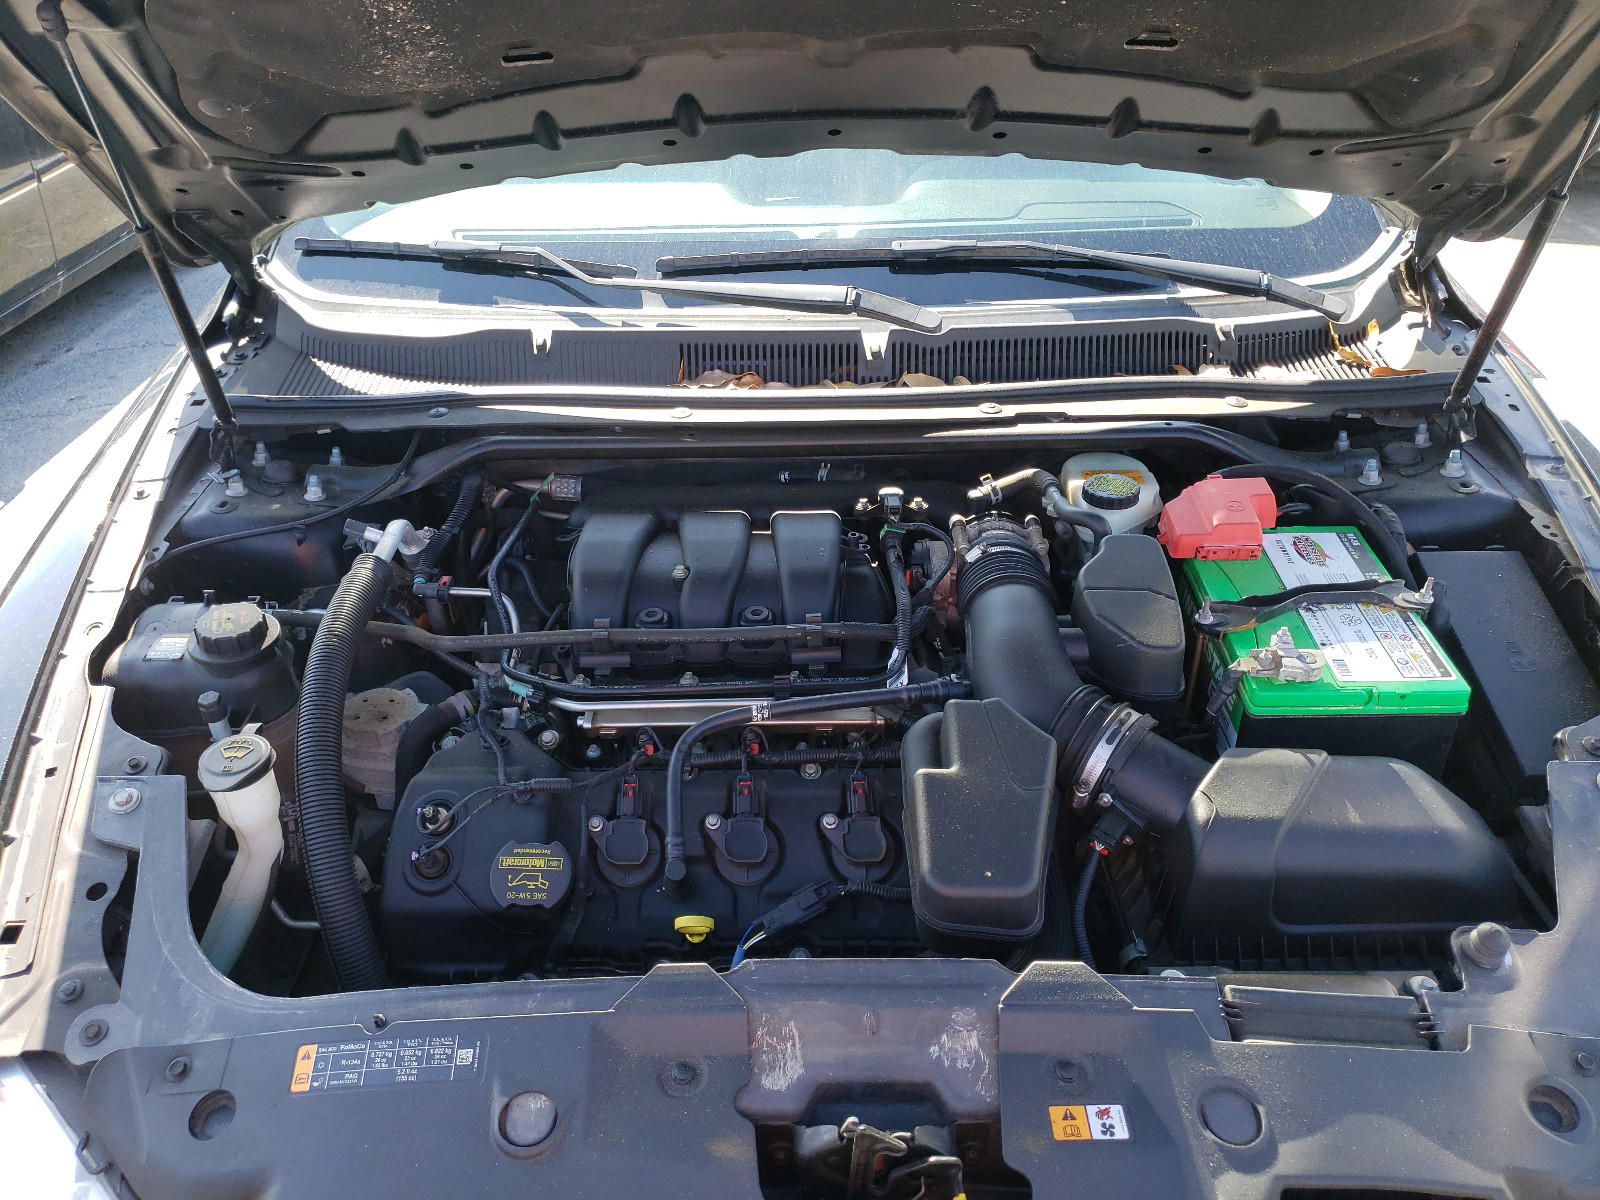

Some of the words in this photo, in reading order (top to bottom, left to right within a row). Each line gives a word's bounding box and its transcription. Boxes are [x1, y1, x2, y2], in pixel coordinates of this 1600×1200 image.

[1275, 539, 1295, 564] AUTOMOTIVE
[1293, 535, 1316, 566] BATTERIES
[1300, 534, 1329, 568] INTERSTATE
[502, 858, 545, 868] Motorcraft
[532, 892, 547, 900] SAE
